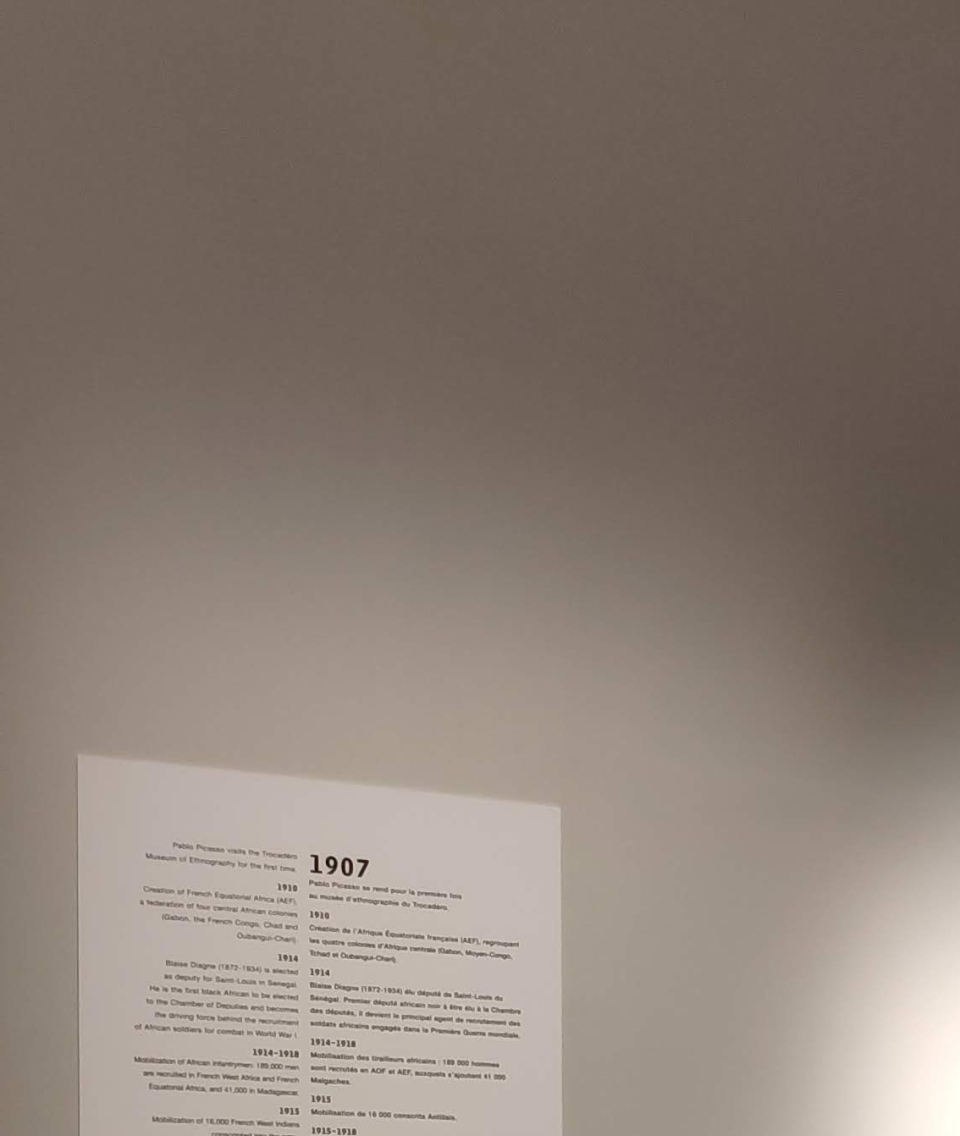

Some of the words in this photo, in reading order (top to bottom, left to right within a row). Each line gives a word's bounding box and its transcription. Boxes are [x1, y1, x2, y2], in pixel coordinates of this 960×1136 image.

[310, 854, 370, 878] 1907
[277, 883, 298, 893] 1910
[309, 911, 329, 920] 1910
[278, 954, 298, 963] 1914
[309, 968, 330, 977] 1914
[311, 1095, 331, 1104] 1915
[279, 1107, 299, 1116] 1915
